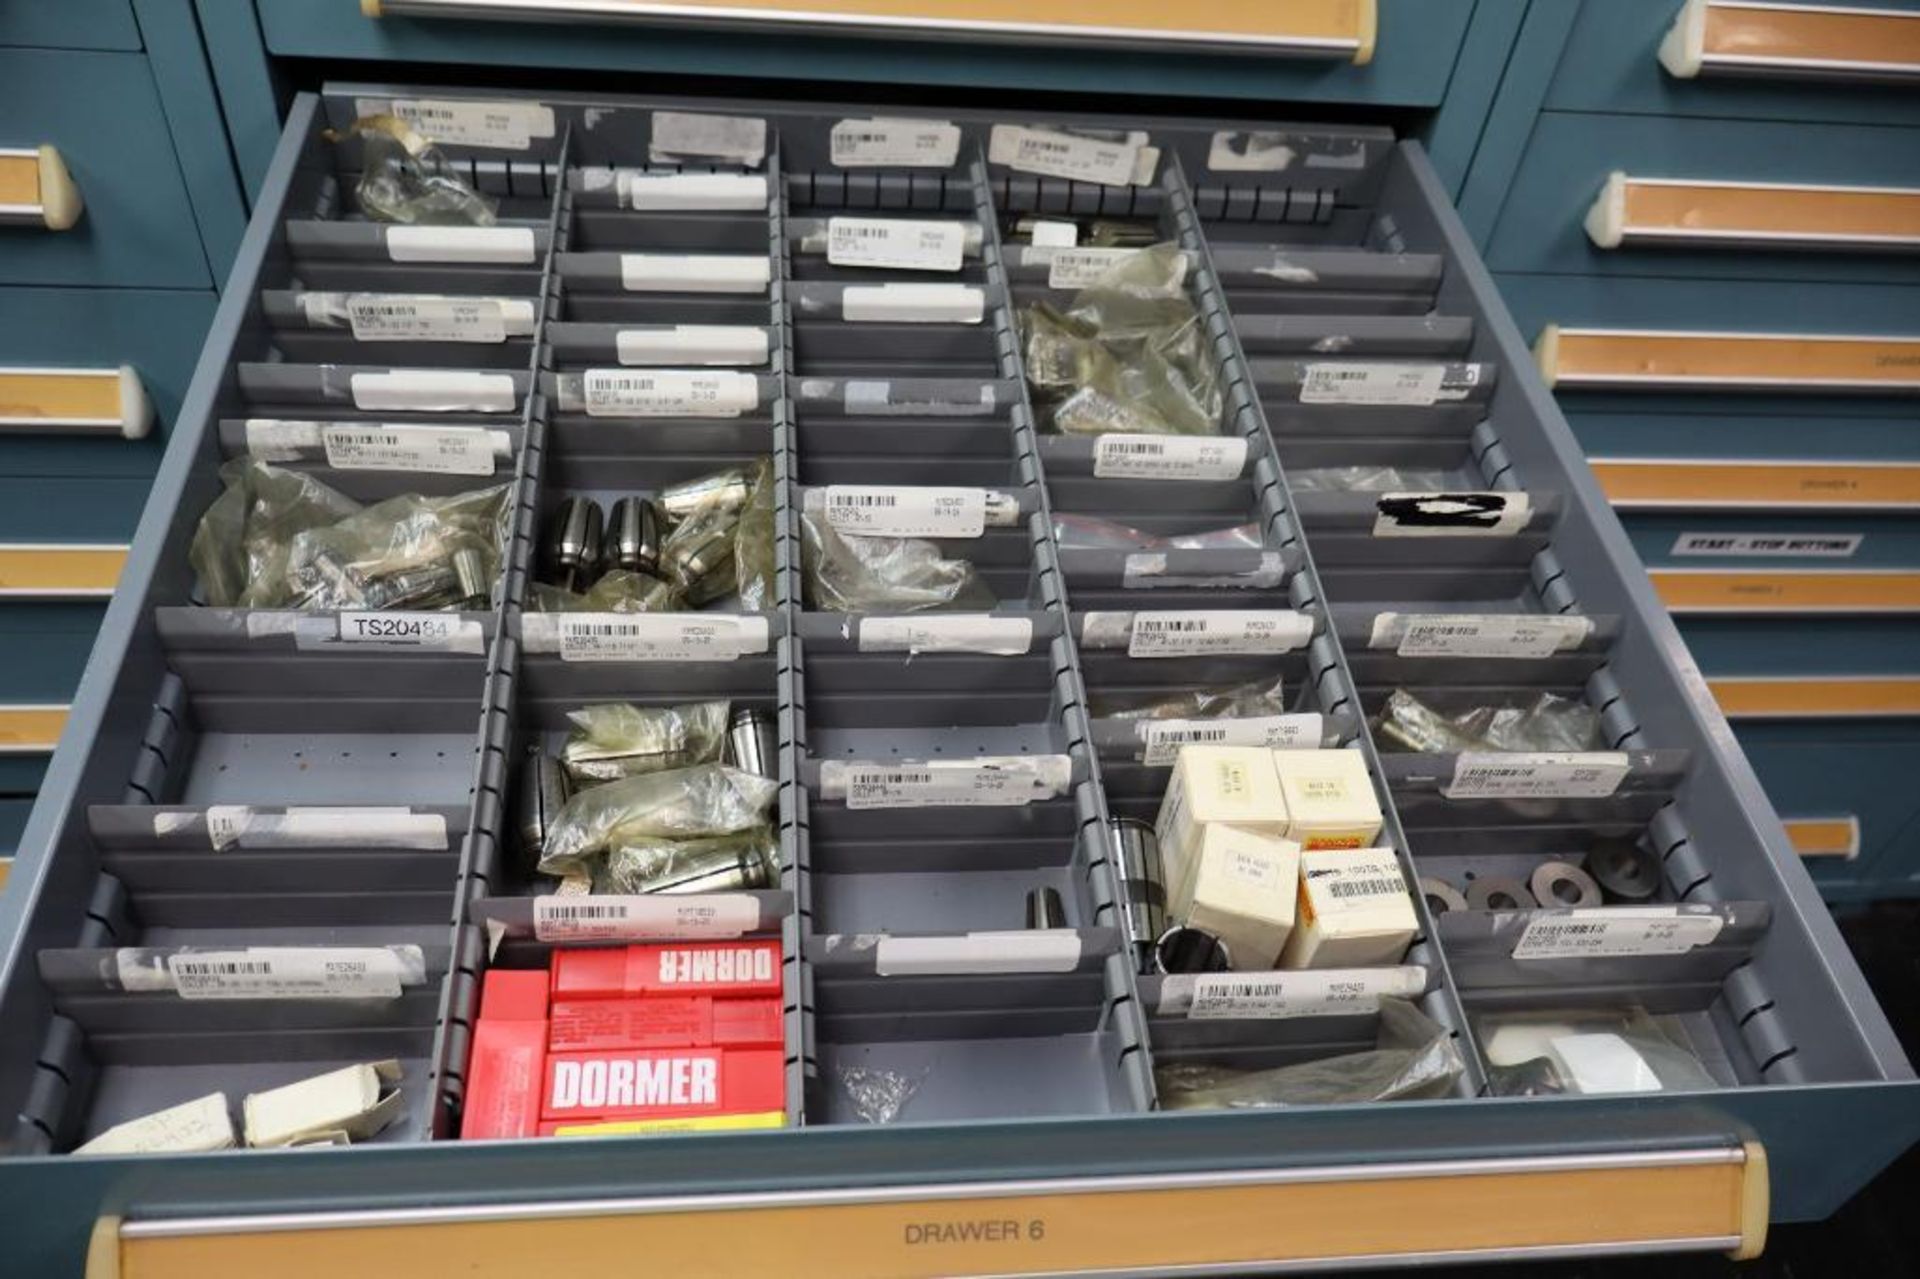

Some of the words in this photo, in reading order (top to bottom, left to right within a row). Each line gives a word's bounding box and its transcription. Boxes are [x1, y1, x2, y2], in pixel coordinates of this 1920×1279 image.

[1689, 539, 1734, 550] START
[1750, 539, 1785, 551] STOP
[1788, 539, 1851, 552] BUTTONS
[354, 617, 448, 639] TS20484
[659, 947, 772, 983] DORMER
[551, 1057, 717, 1109] DORMER
[905, 1220, 1020, 1244] DRAWER
[1029, 1219, 1045, 1242] 6
